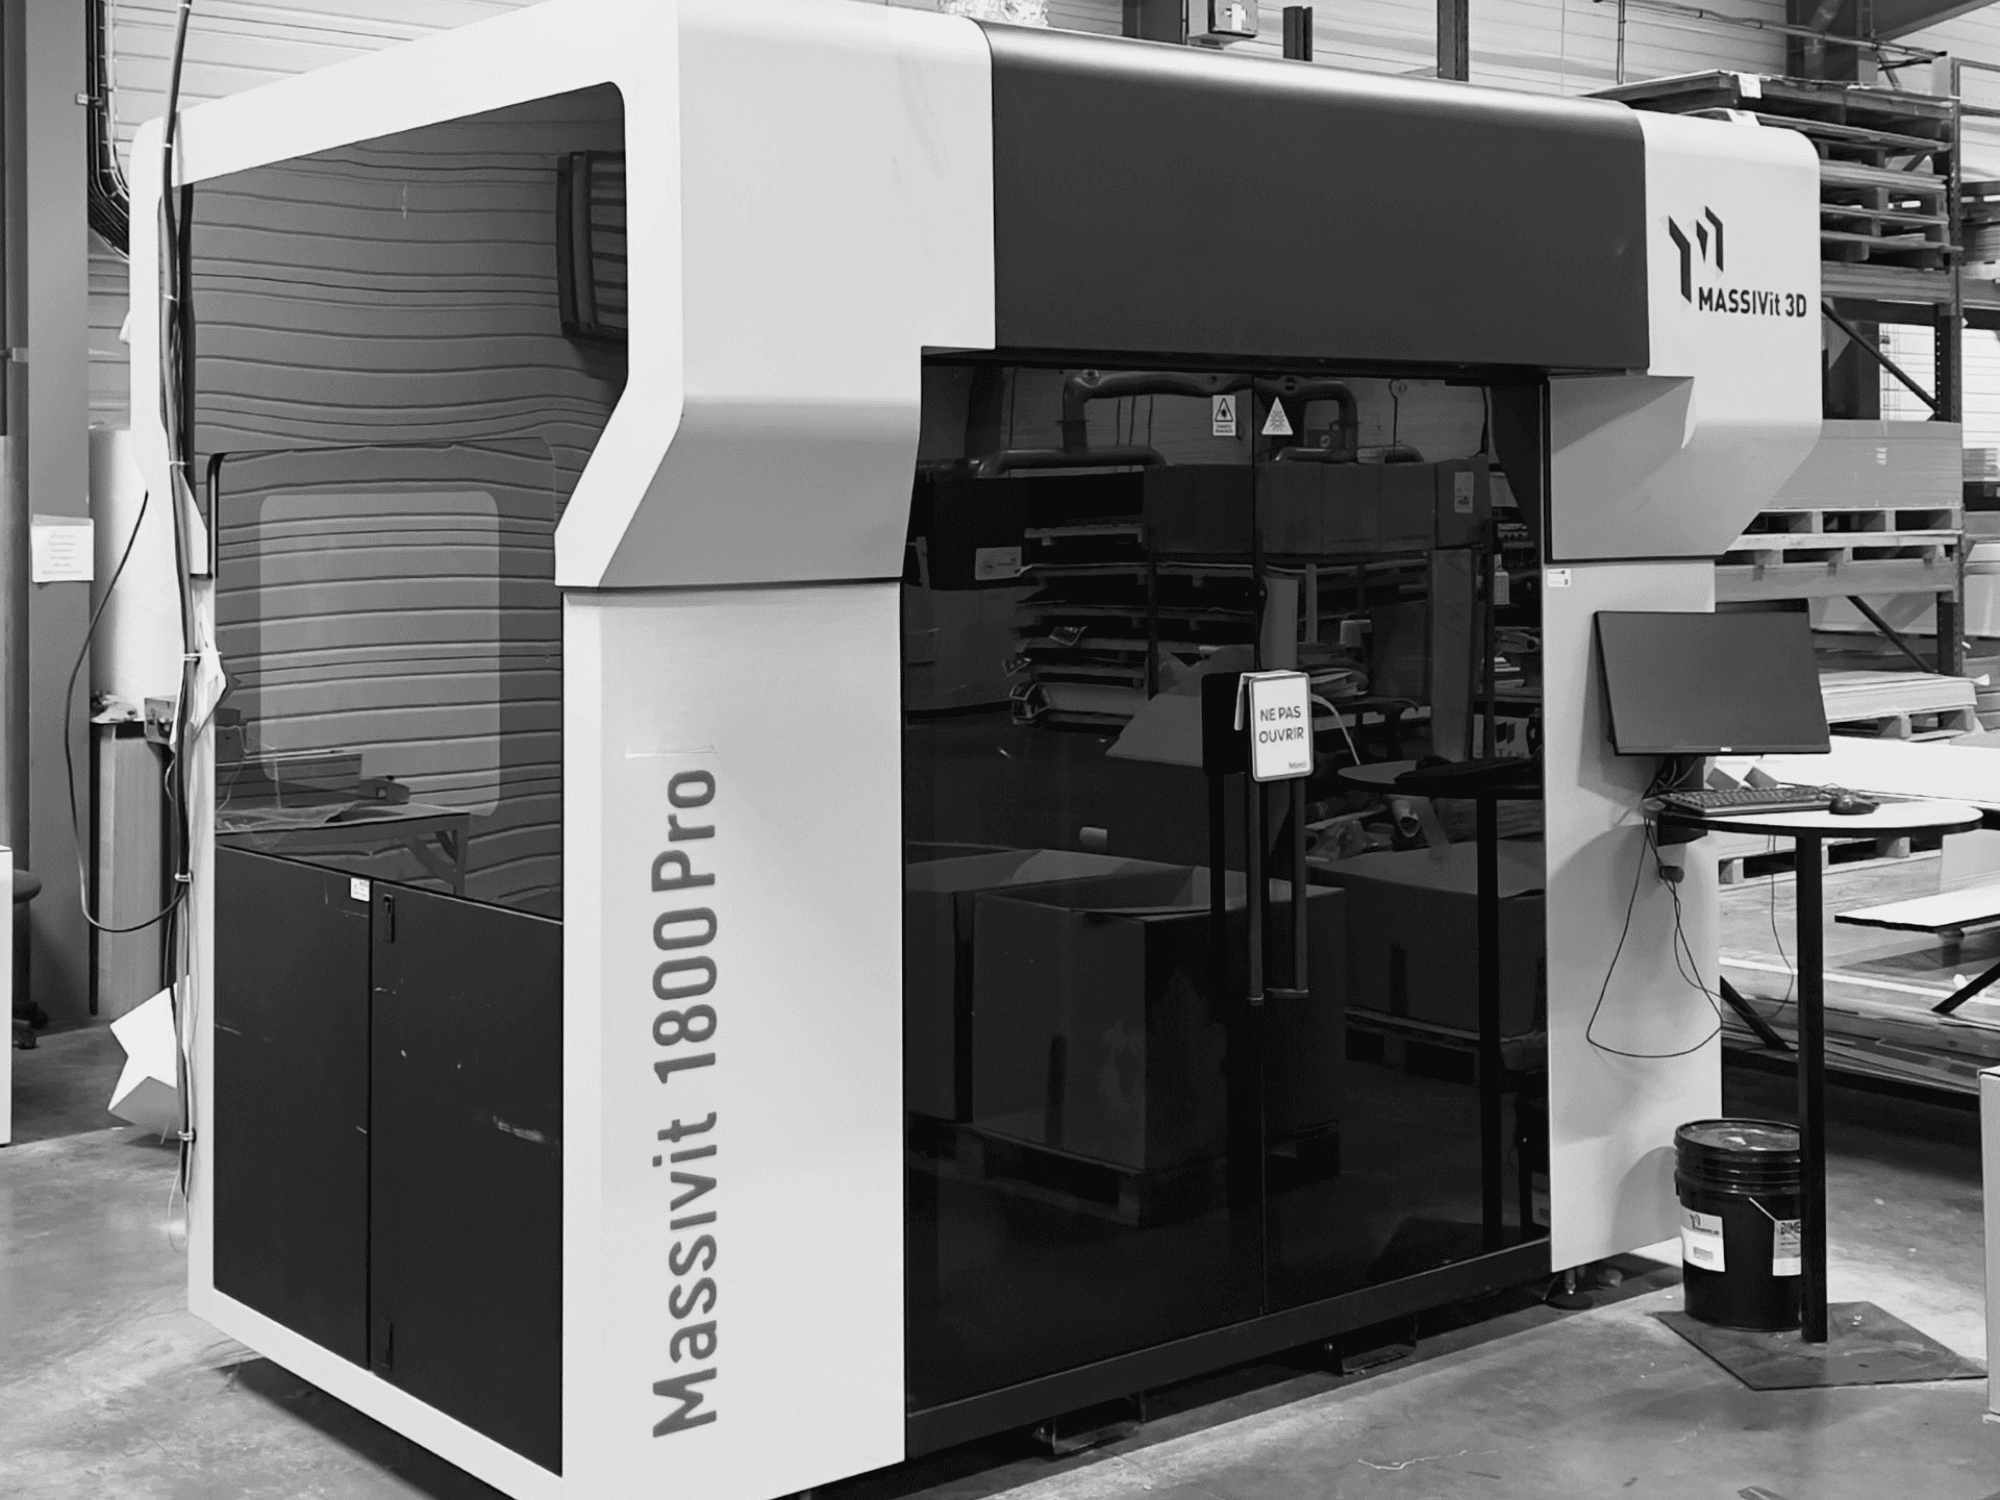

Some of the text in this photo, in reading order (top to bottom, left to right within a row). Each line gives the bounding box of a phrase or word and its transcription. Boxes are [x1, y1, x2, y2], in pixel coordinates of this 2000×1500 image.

[1698, 286, 1808, 318] MASSIVit 3D
[1259, 705, 1302, 722] NE PAS
[1258, 726, 1305, 744] OUVRIR
[651, 769, 718, 1438] Massivit 1800 Pro
